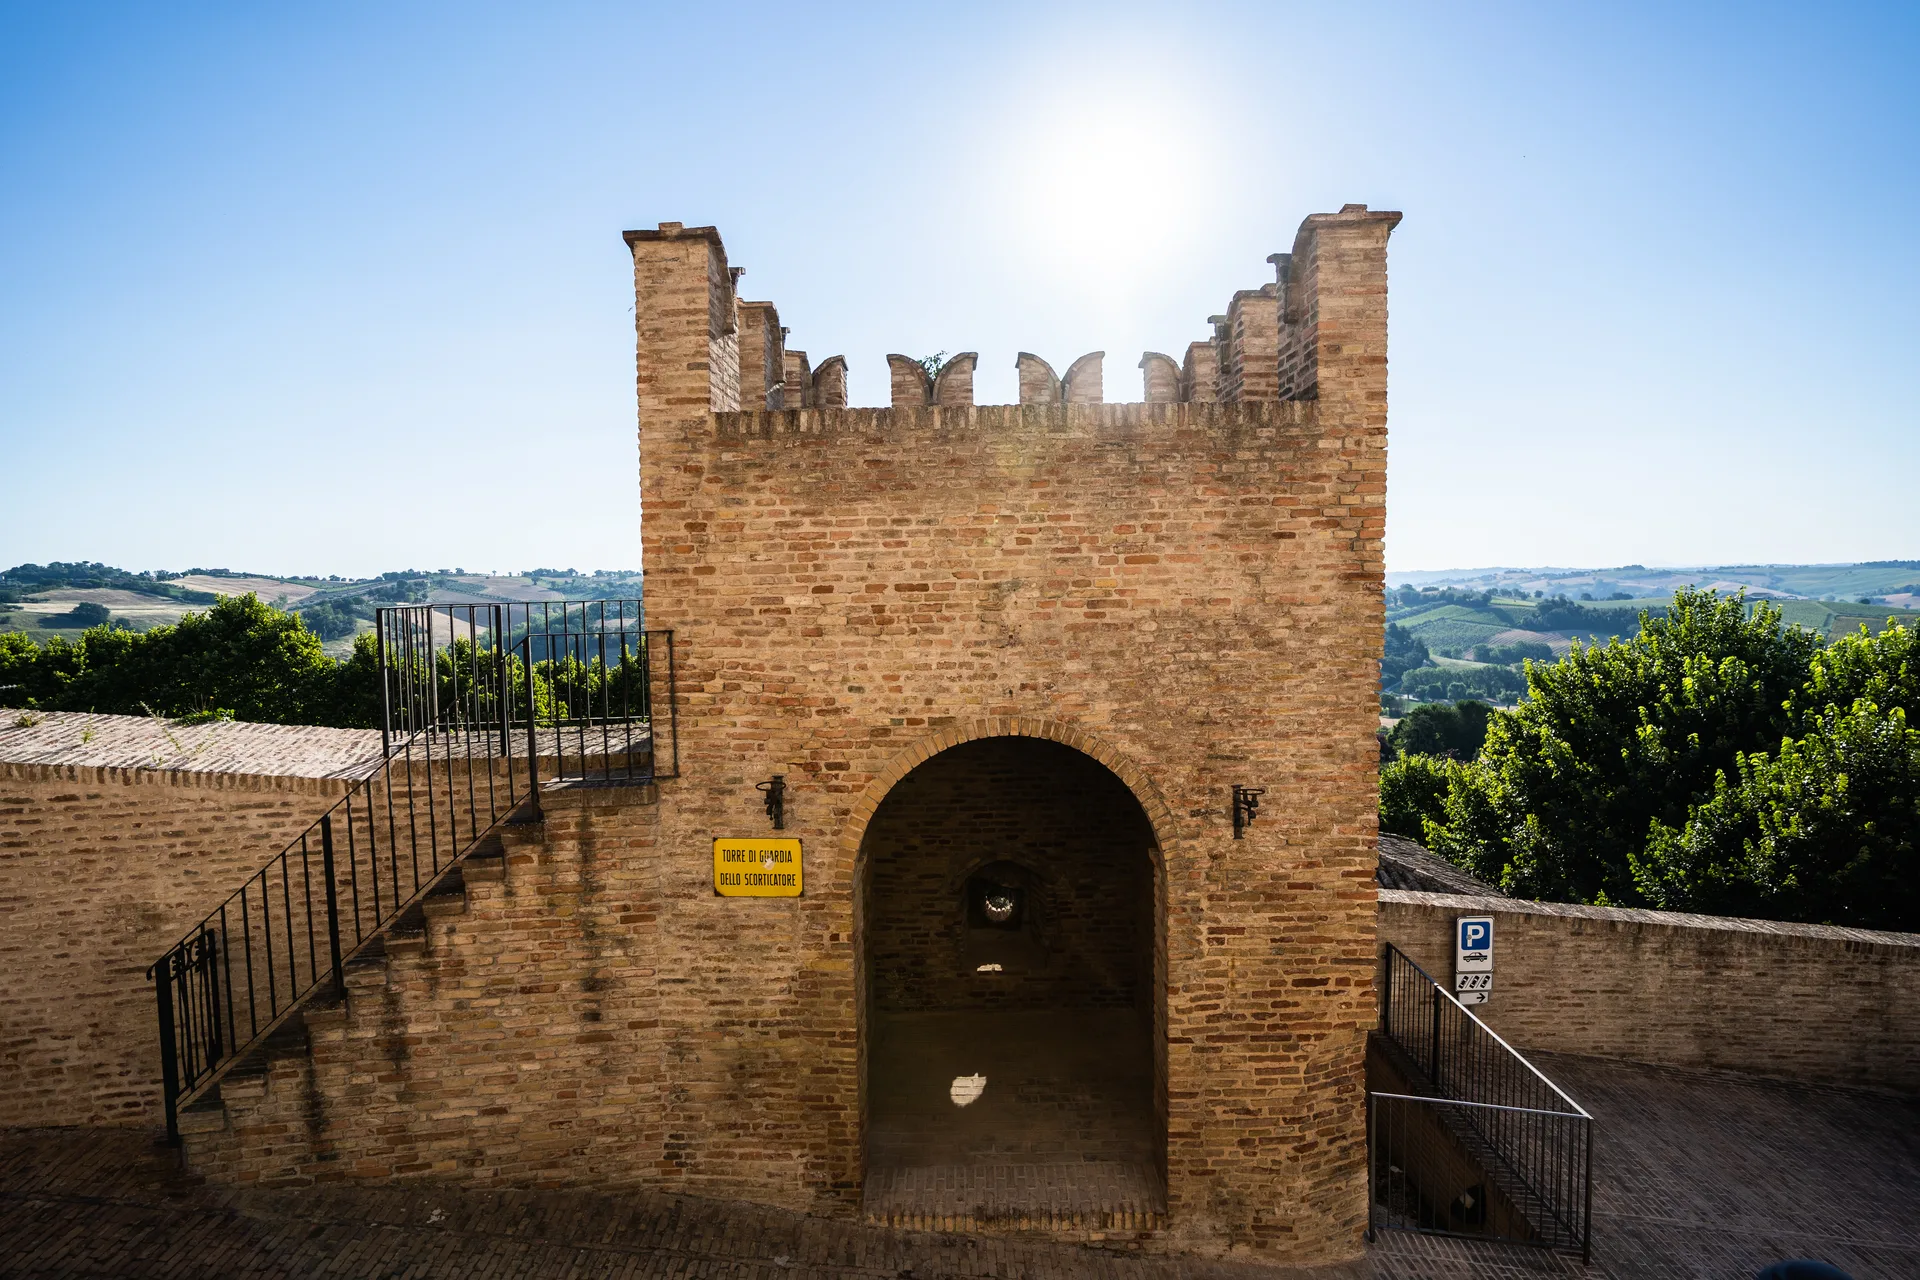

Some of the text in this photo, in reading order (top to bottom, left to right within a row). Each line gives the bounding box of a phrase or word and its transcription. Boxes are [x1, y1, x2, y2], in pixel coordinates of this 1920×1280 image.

[722, 849, 746, 863] TORRE
[748, 849, 757, 863] DI
[720, 872, 797, 887] DELLO SCORTICATORE
[1467, 925, 1484, 947] P
